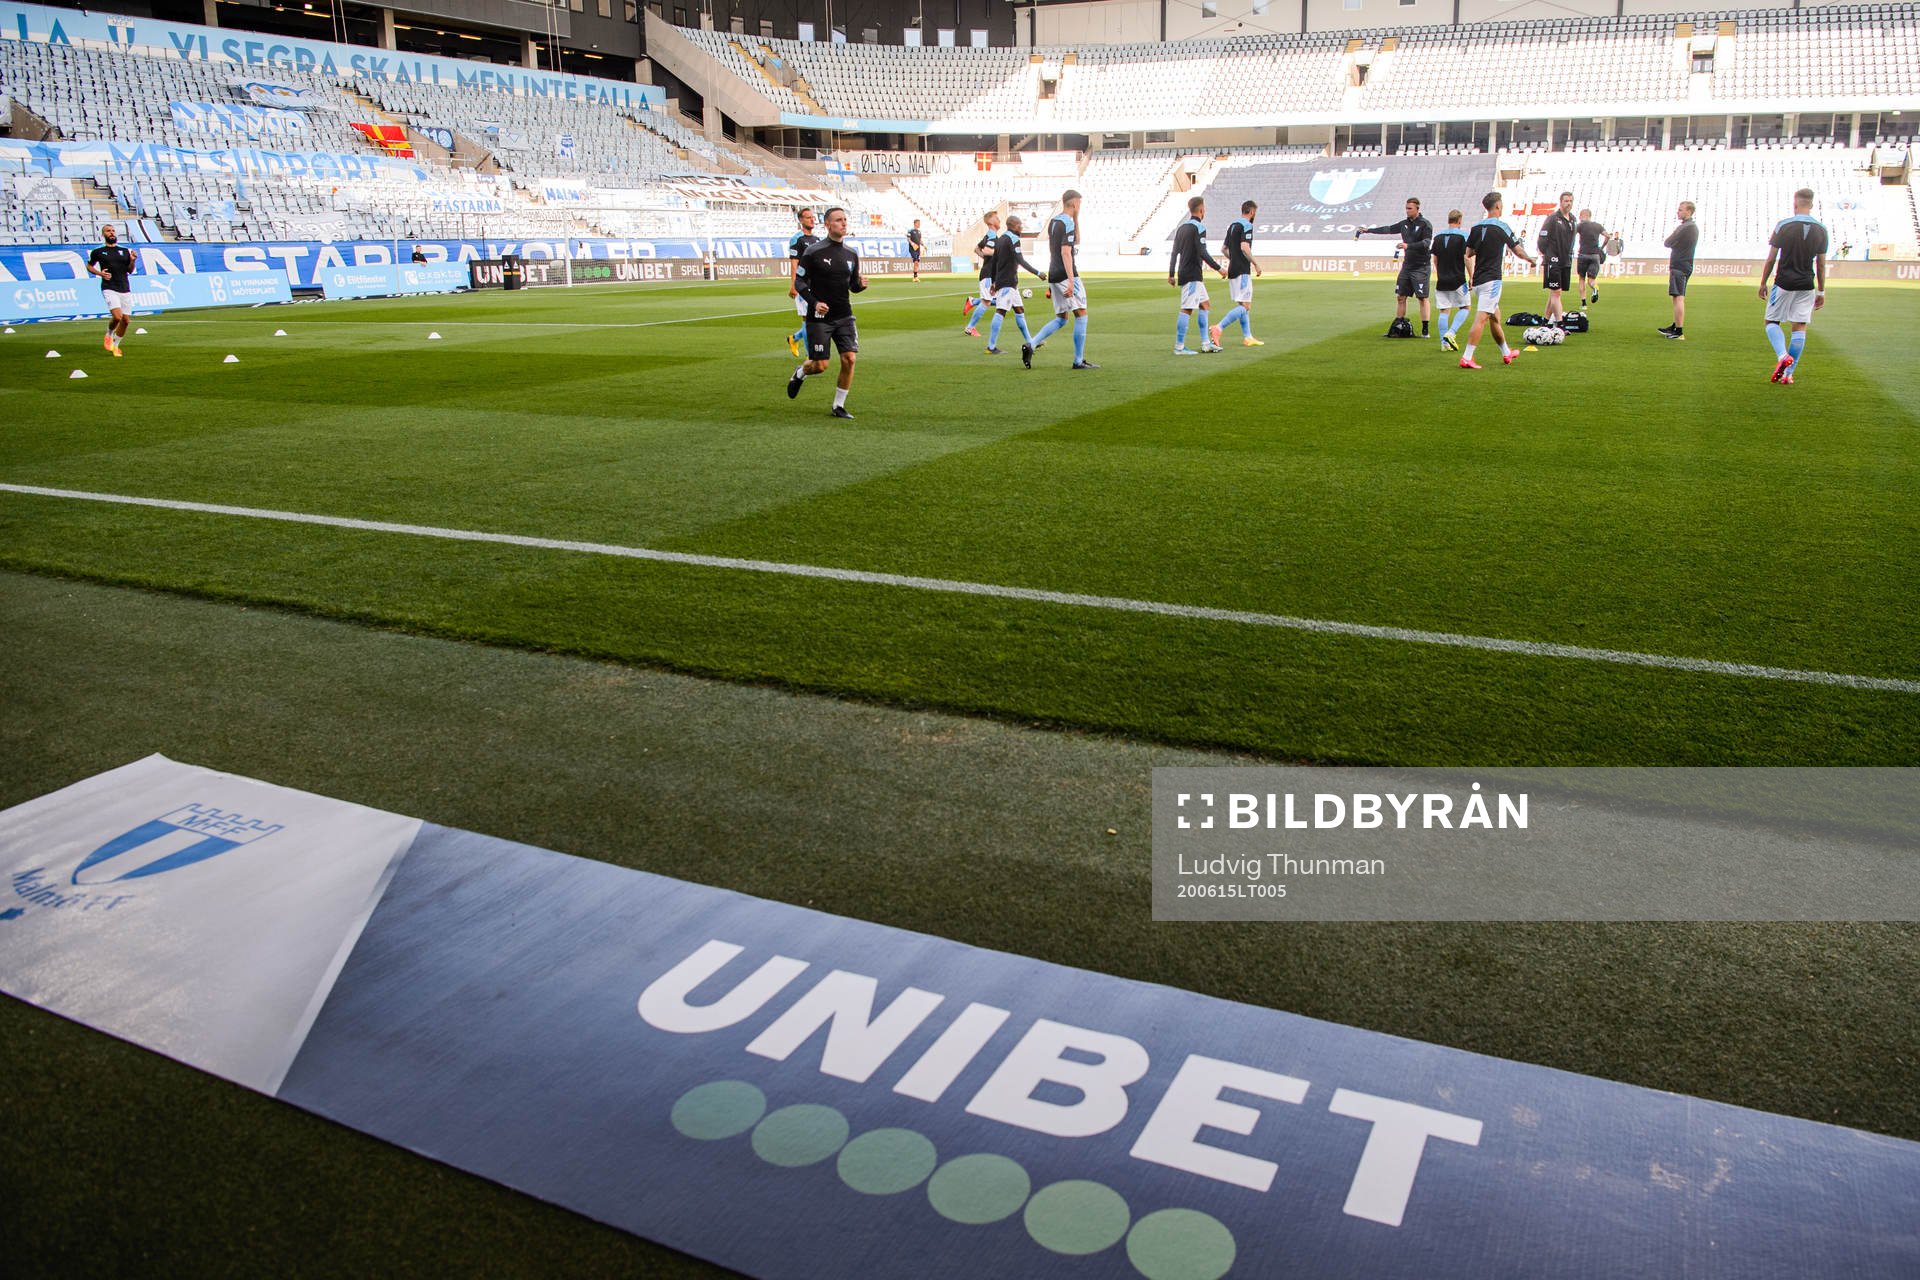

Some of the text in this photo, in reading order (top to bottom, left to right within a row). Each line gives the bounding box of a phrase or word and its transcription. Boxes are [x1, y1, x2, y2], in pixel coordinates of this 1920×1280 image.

[168, 31, 209, 61] VI
[222, 38, 340, 77] SEGRA
[350, 53, 440, 86] SKALL
[456, 66, 515, 95] MEN
[522, 75, 577, 100] INTE
[585, 83, 650, 111] FALLA
[208, 146, 381, 180] SUPPORT
[860, 153, 901, 174] ØLTRAS
[1291, 201, 1376, 214] Malmö FF
[1256, 222, 1310, 233] STÅR
[223, 238, 393, 285] STÅR
[860, 261, 889, 273] NIBET
[1302, 259, 1358, 272] UNIBET
[1364, 261, 1392, 271] SPELA
[475, 263, 551, 285] UNBET
[616, 263, 674, 280] UNIBET
[681, 263, 705, 276] SPEL
[34, 287, 79, 302] bemt
[637, 939, 1484, 1228] UNIBET
